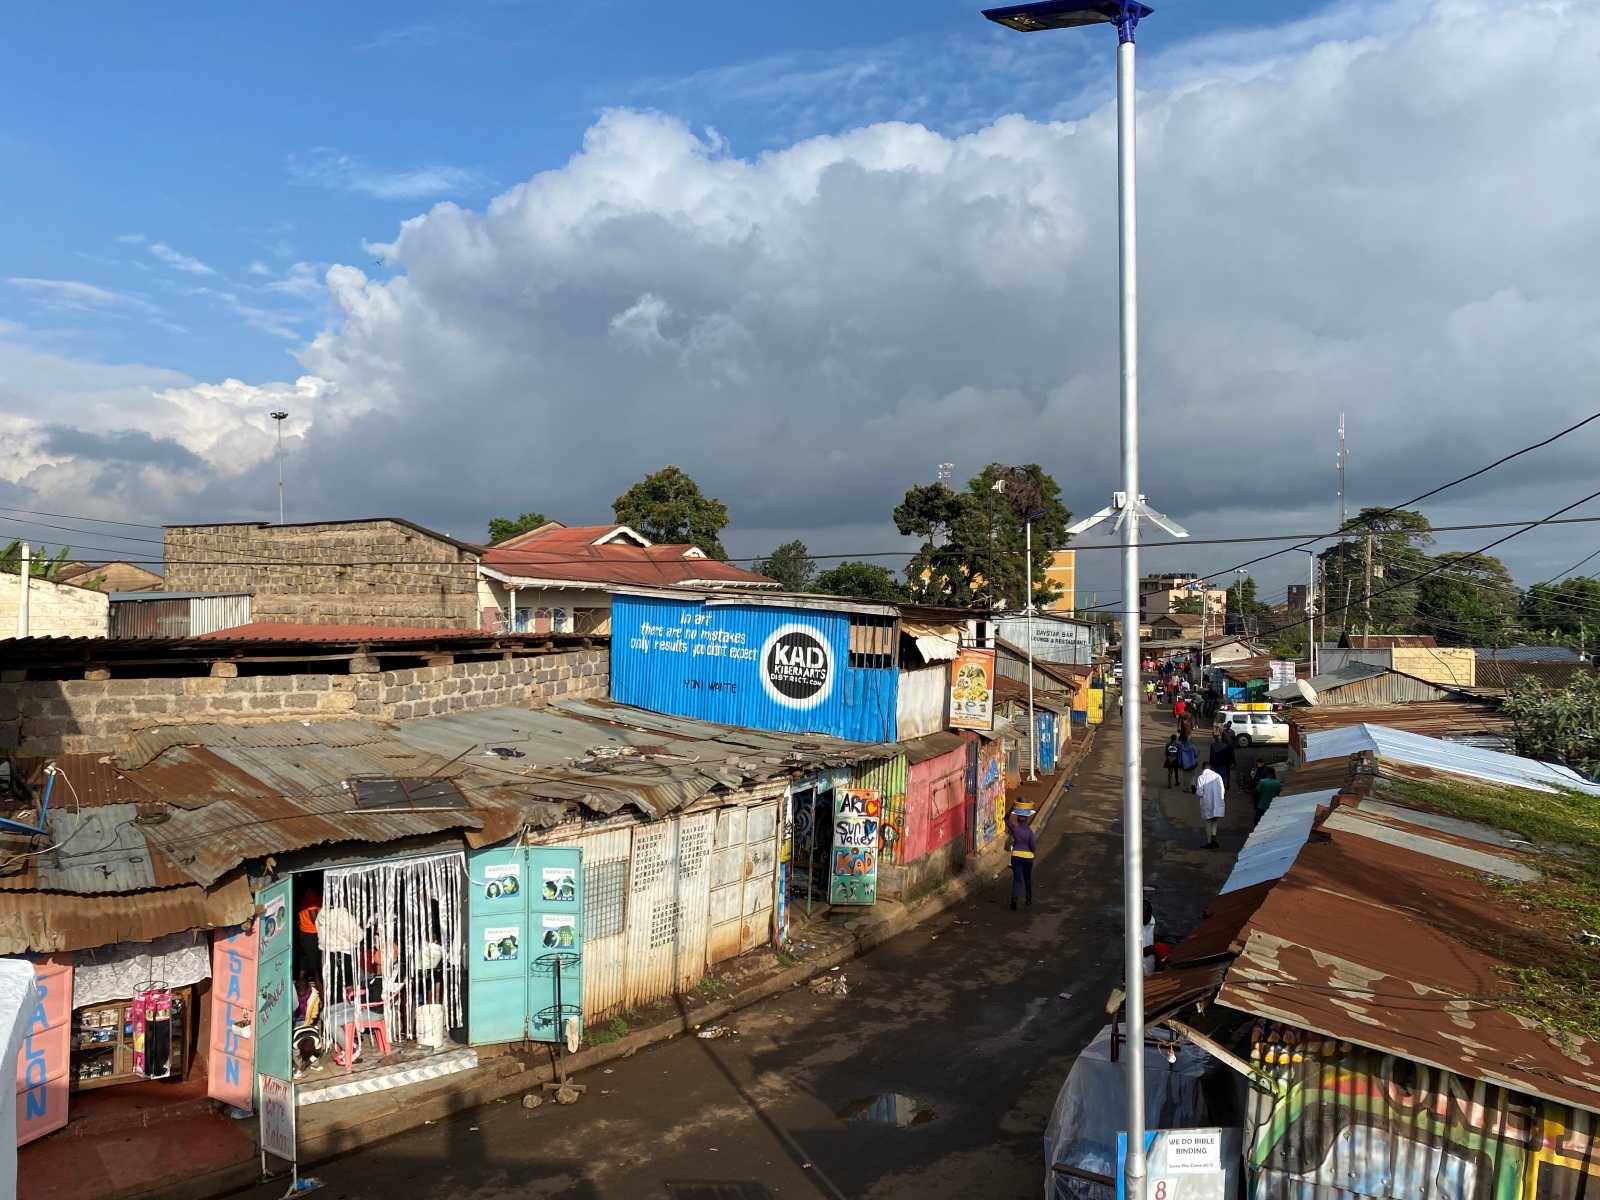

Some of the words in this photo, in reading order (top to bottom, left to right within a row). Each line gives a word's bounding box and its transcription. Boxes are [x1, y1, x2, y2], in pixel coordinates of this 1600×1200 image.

[694, 611, 712, 626] art
[640, 621, 663, 637] there
[666, 627, 682, 638] are
[685, 629, 698, 640] no
[701, 628, 746, 645] mistakes
[630, 637, 649, 654] only
[654, 639, 688, 653] results
[729, 646, 759, 662] expect
[774, 642, 824, 669] KAD
[774, 664, 803, 676] KIBERA
[802, 667, 826, 680] ARTS
[840, 792, 868, 815] ART
[224, 948, 242, 1088] SALON
[1175, 1147, 1208, 1155] BINDING
[1194, 1137, 1215, 1145] BIBLE
[1155, 1180, 1167, 1200] 8
